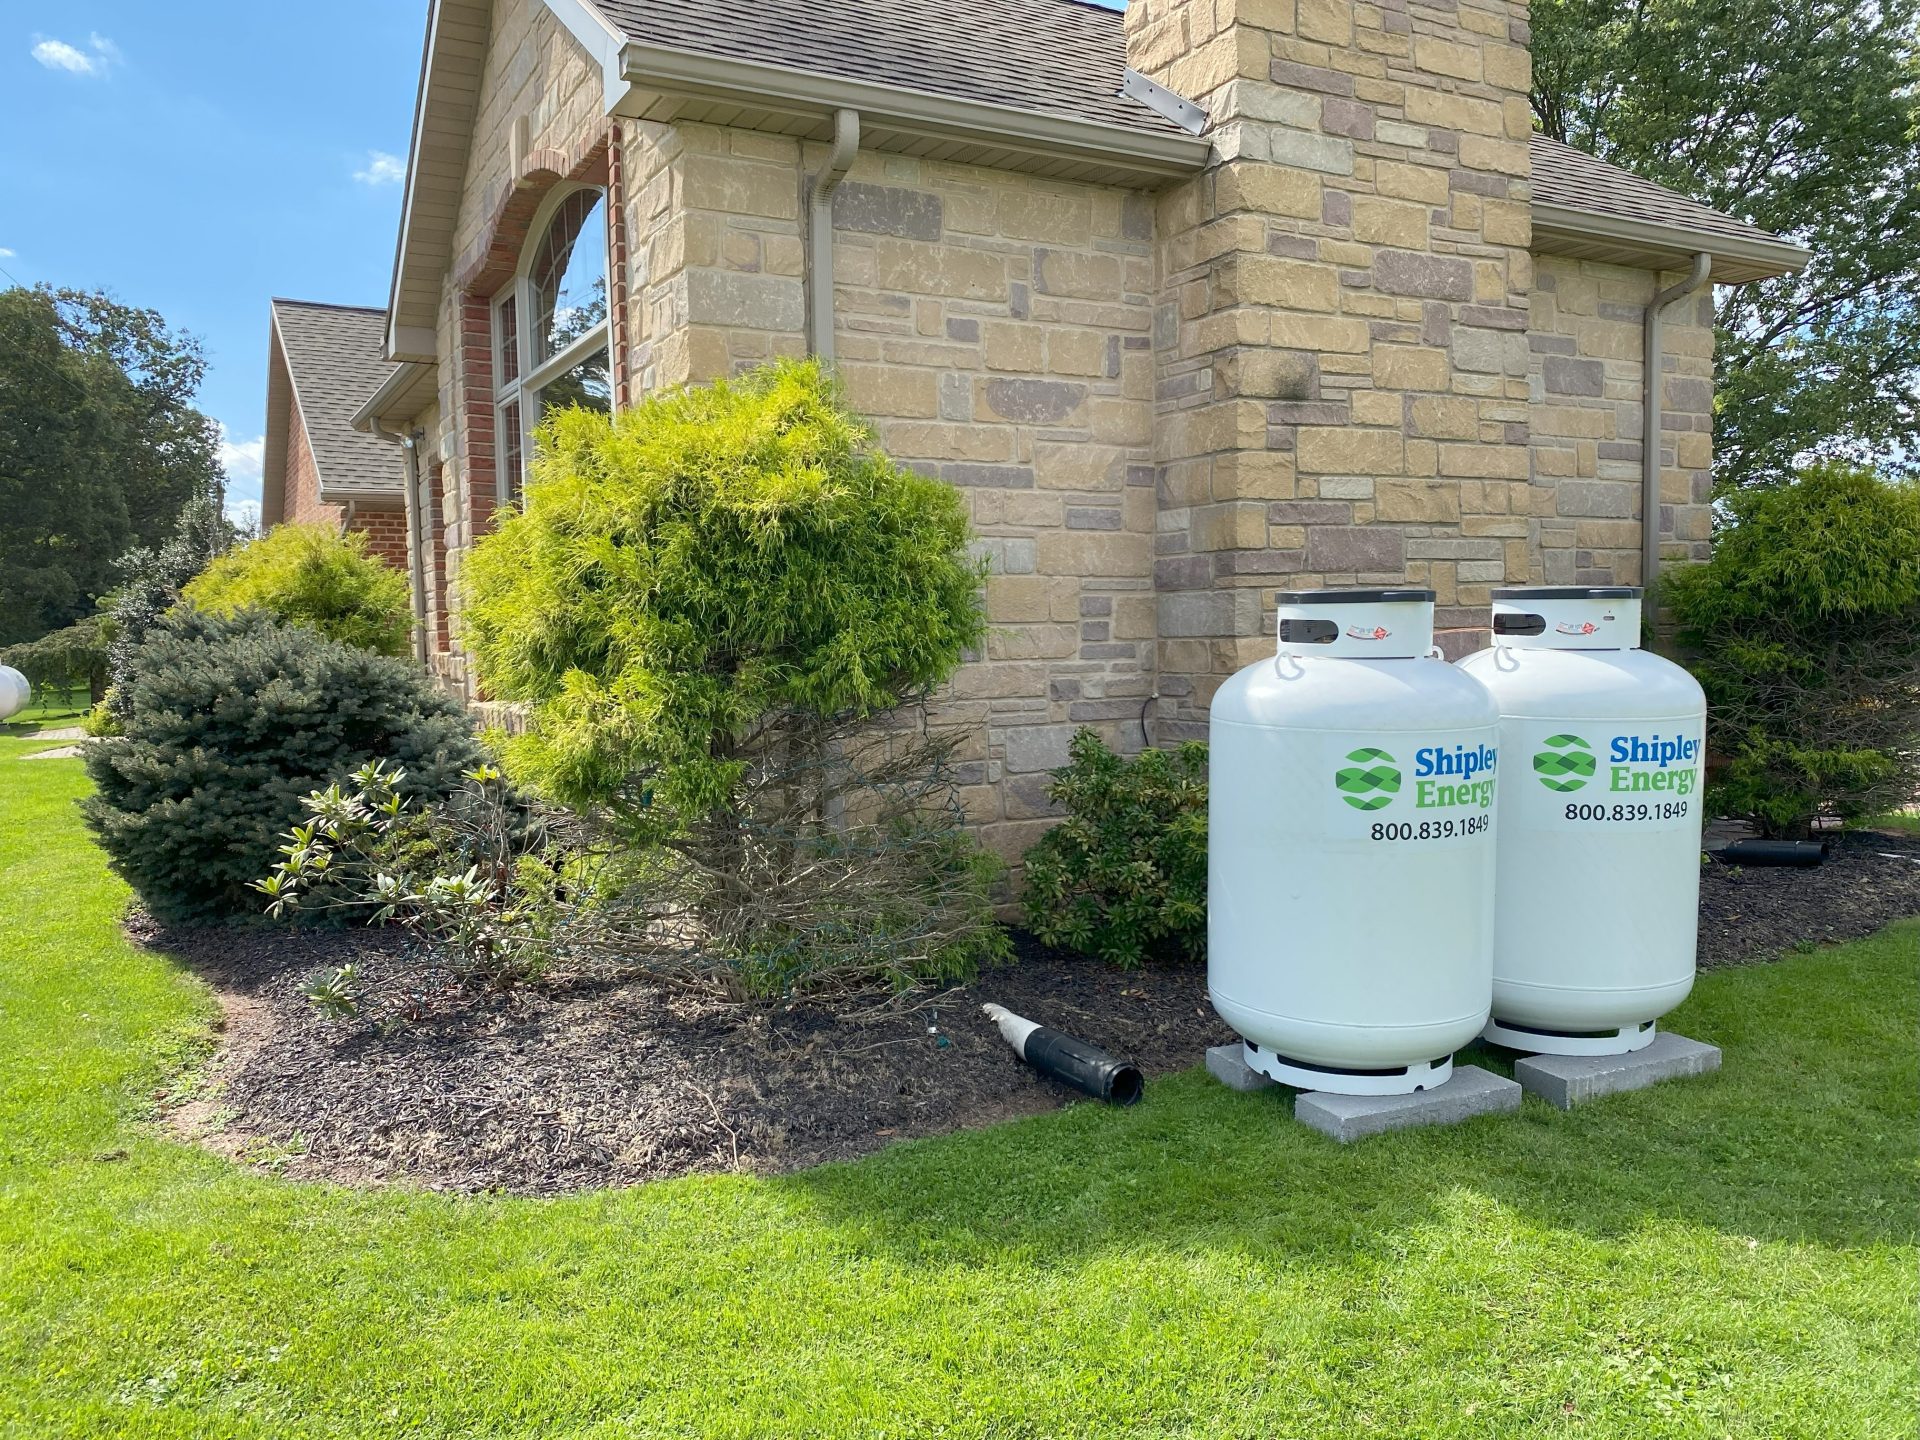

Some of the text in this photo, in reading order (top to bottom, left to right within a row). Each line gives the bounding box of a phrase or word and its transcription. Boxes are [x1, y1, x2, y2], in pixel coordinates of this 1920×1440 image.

[1415, 744, 1498, 780] Shipley
[1610, 735, 1701, 767] Shipley
[1415, 778, 1496, 808] Energy
[1609, 766, 1697, 796] Energy
[1565, 801, 1688, 821] 800.839.1849
[1371, 814, 1489, 841] 800.839.1849
